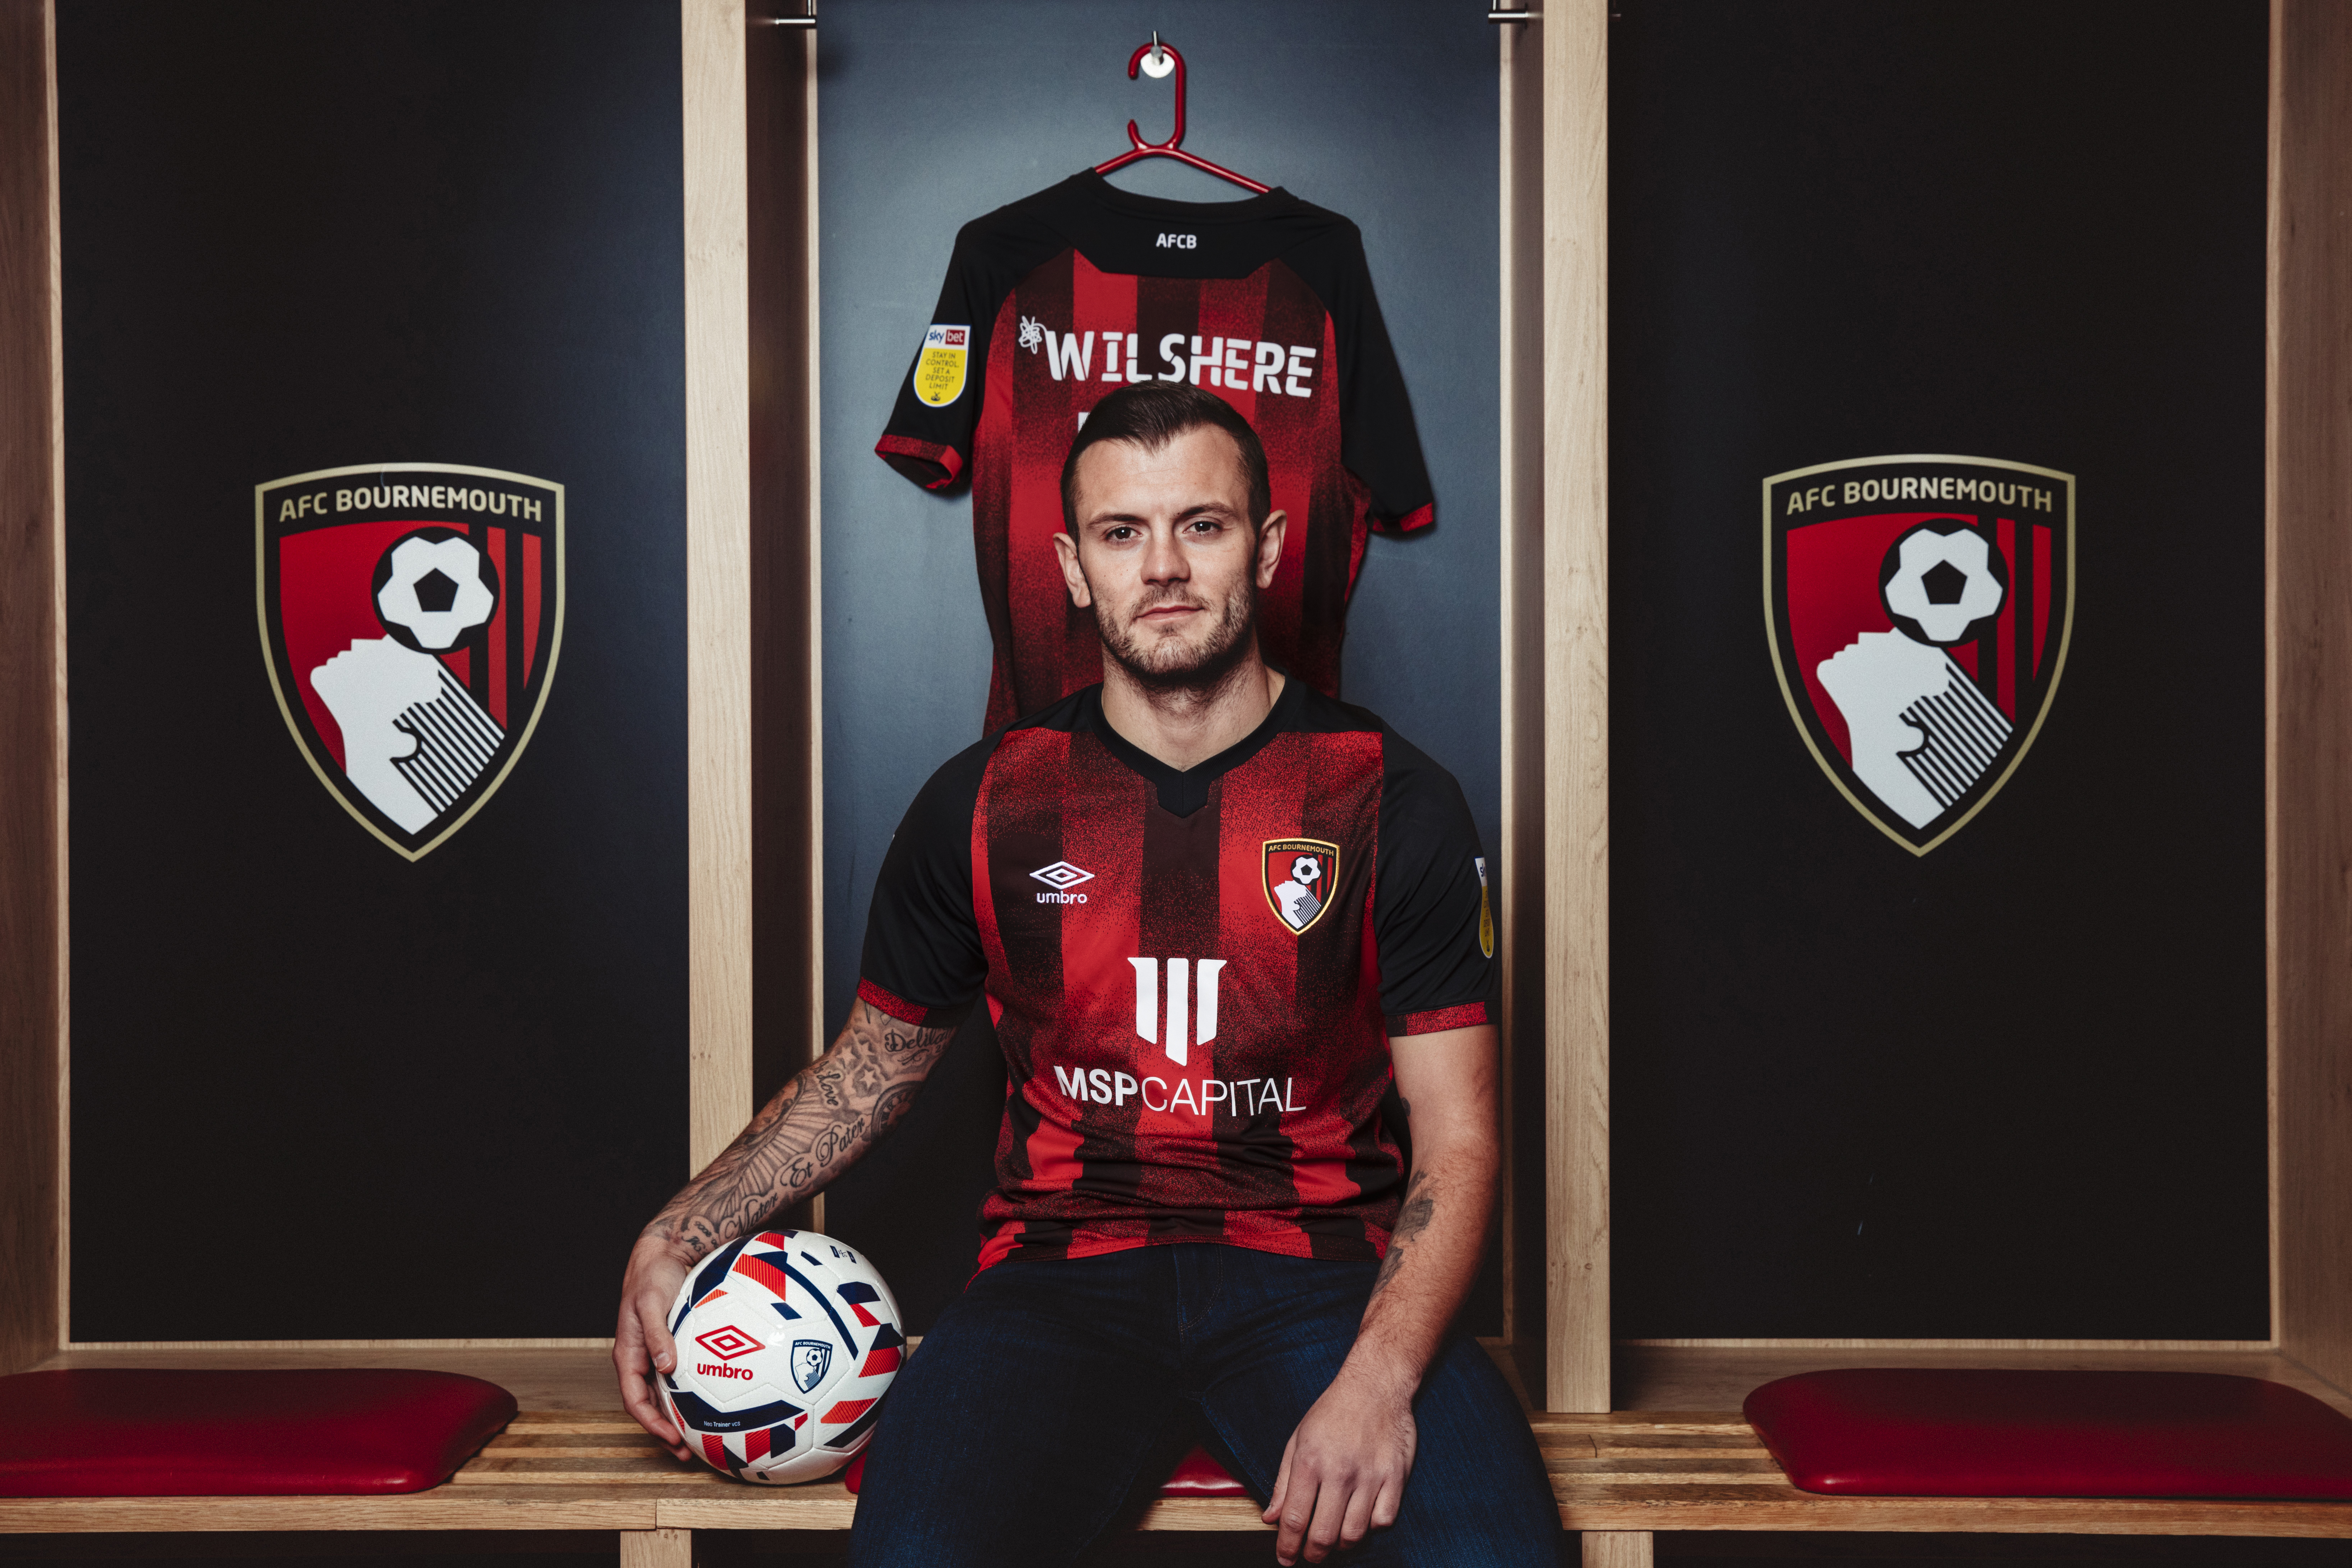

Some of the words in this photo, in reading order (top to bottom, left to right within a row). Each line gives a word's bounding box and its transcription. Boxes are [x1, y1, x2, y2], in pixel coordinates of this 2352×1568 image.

[1156, 233, 1197, 249] AFCB
[929, 330, 945, 343] sky
[947, 330, 963, 343] bet
[1044, 330, 1317, 398] WILSHERE
[926, 374, 954, 383] DEPOSIT
[279, 492, 327, 522] AFC
[336, 486, 541, 522] BOURNEMOUTH
[1786, 484, 1835, 515] AFC
[1844, 477, 2052, 513] BOURNEMOUTH
[1283, 844, 1334, 856] BOURNEMOUTH
[1037, 890, 1087, 904] umbro
[816, 1071, 841, 1106] Love
[780, 1157, 814, 1188] Et
[816, 1117, 865, 1168] Pater
[697, 1363, 753, 1380] umbro
